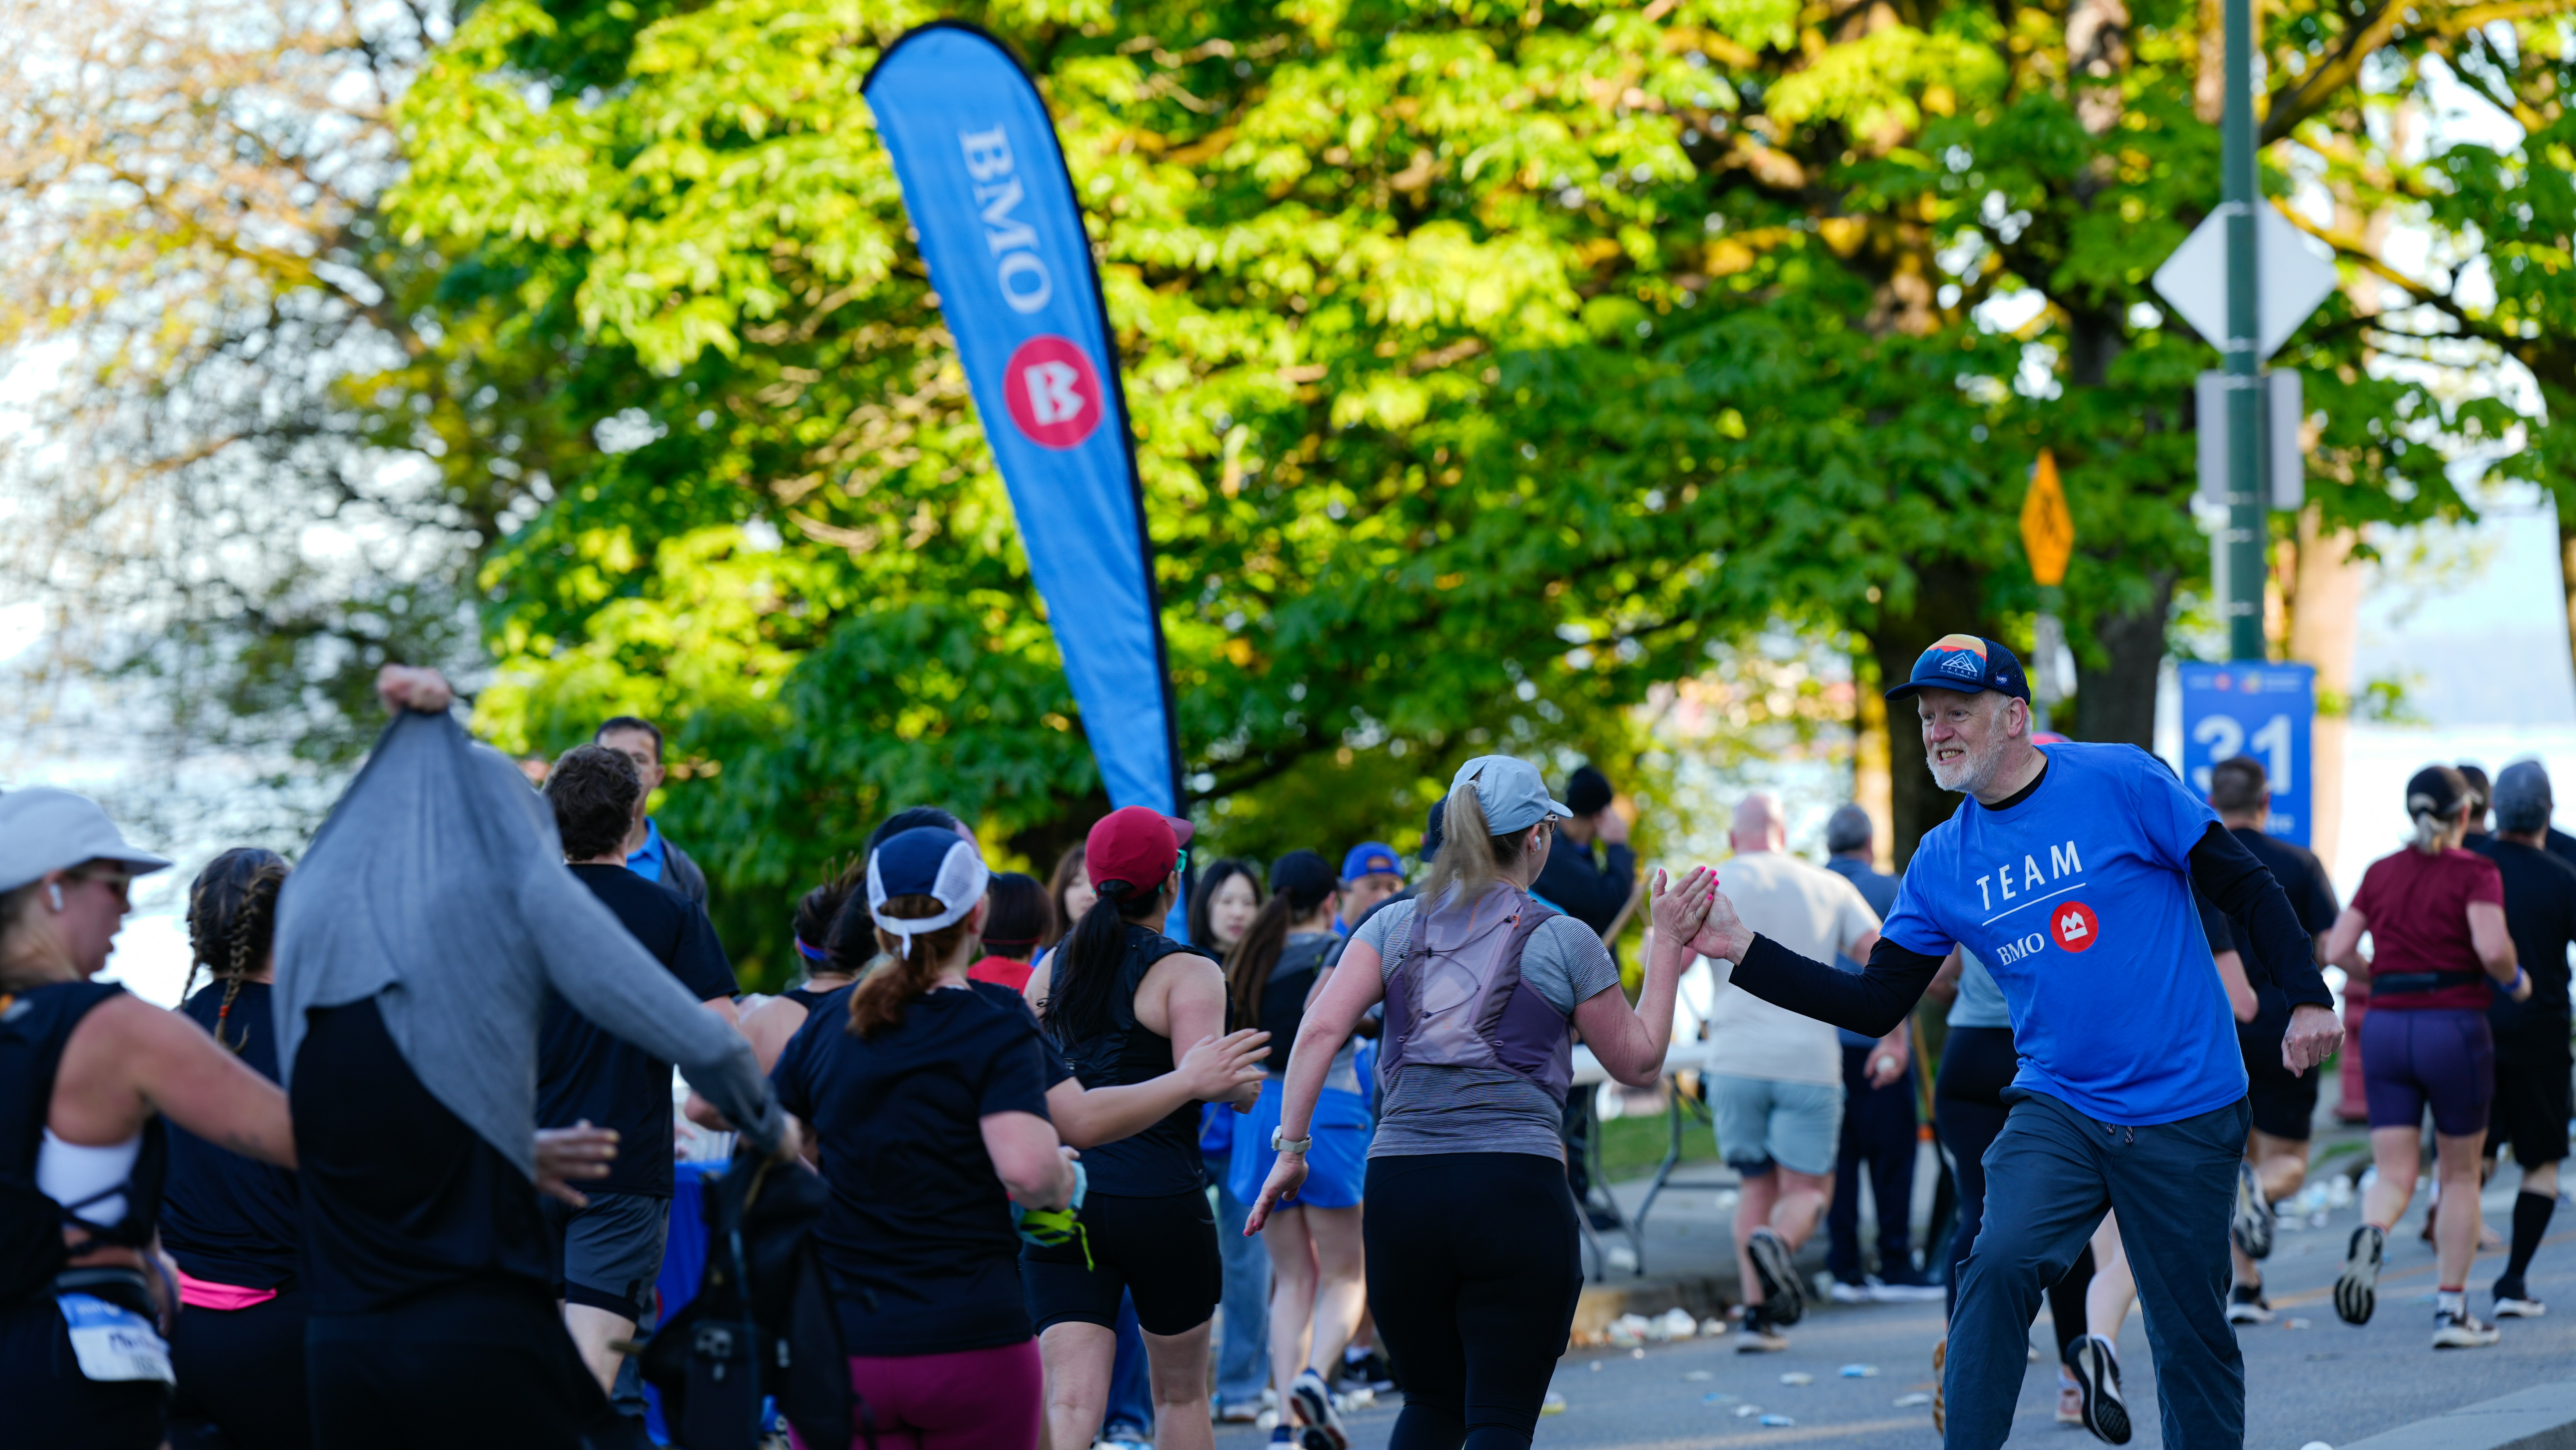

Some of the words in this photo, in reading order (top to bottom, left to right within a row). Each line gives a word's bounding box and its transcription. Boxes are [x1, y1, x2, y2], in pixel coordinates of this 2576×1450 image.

[959, 121, 1053, 314] BMO
[2192, 713, 2292, 796] 31
[1976, 840, 2082, 911] TEAM
[1996, 933, 2045, 966] BMO
